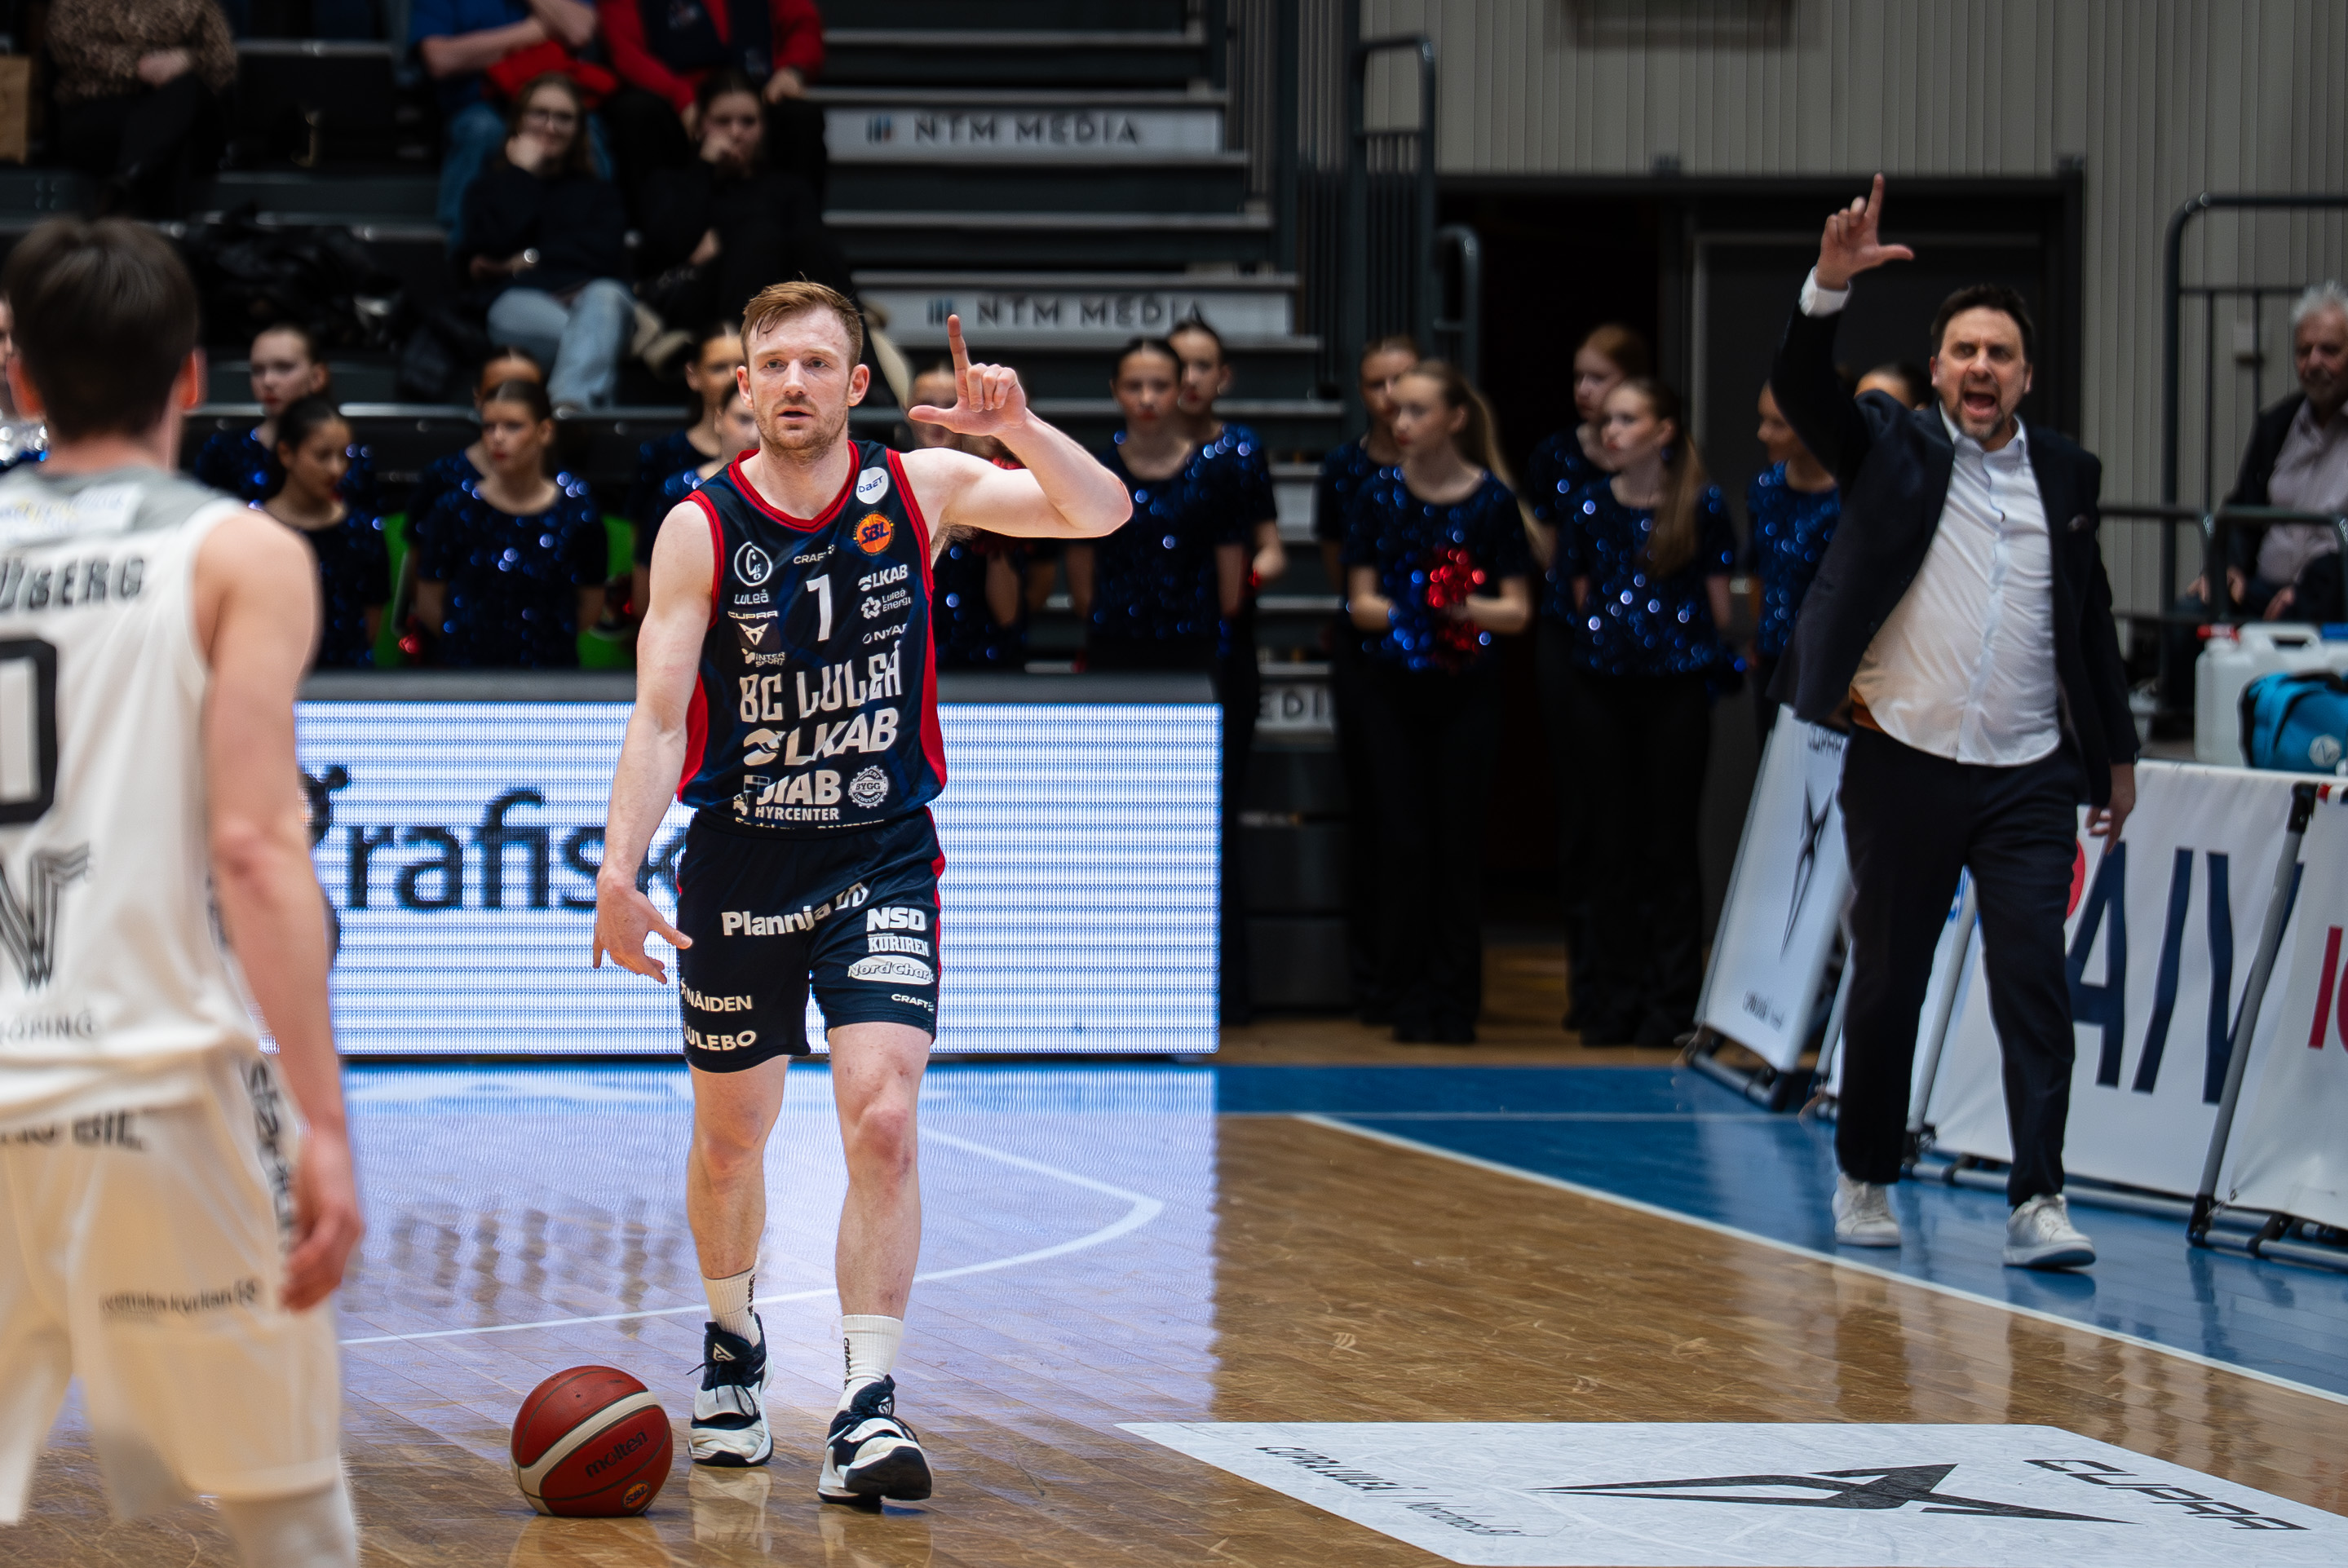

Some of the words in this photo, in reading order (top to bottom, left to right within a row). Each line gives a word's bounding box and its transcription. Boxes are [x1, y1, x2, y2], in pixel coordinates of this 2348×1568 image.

[913, 115, 996, 144] NTM
[1015, 115, 1139, 144] MEDIA
[977, 297, 1059, 326] NTM
[1079, 297, 1206, 327] MEDIA
[860, 522, 890, 545] SBL
[727, 610, 779, 620] CUPRA
[806, 573, 832, 643] 1
[739, 674, 784, 722] BC
[784, 707, 899, 766] LKAB
[856, 782, 881, 790] BYGG
[755, 806, 841, 821] HYRCENTER
[721, 902, 831, 936] Plannja
[866, 907, 926, 932] NSD
[867, 935, 930, 957] KURIREN
[891, 993, 929, 1009] CRAFT
[586, 1430, 649, 1478] molten
[2023, 1459, 2311, 1530] CUPRA
